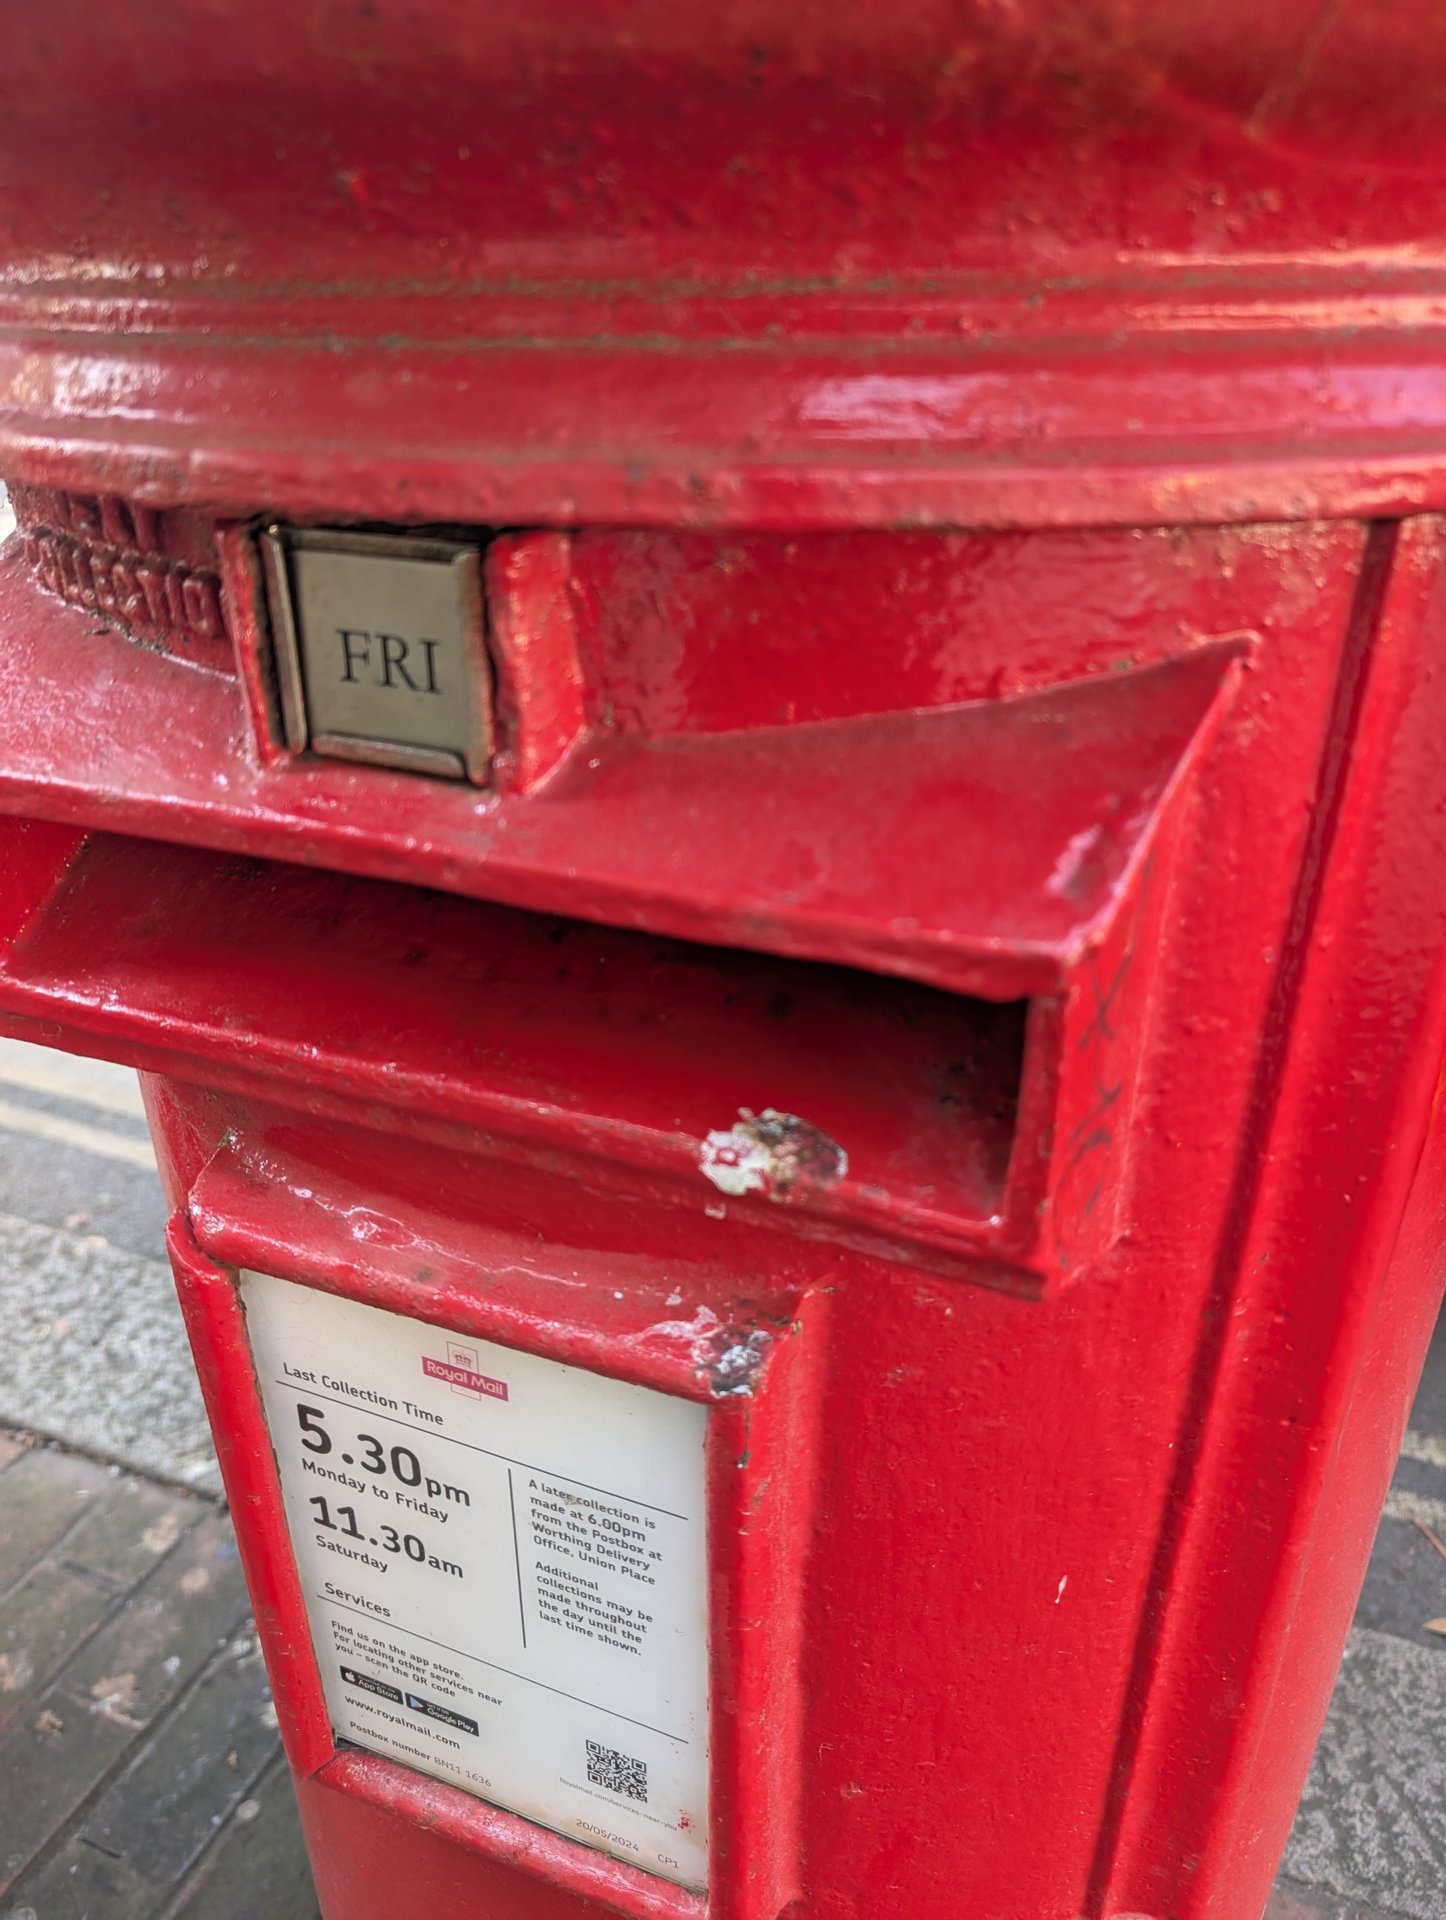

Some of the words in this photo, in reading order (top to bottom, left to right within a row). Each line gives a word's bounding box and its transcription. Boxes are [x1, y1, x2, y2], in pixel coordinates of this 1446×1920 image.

[336, 627, 443, 695] FRI
[283, 1362, 317, 1383] Last
[322, 1375, 398, 1410] Collection
[402, 1401, 443, 1425] Time
[427, 1361, 466, 1382] Royal
[471, 1376, 503, 1395] Mail
[297, 1403, 470, 1506] 5.30pm
[302, 1458, 366, 1493] Monday
[372, 1485, 388, 1499] to
[396, 1492, 448, 1523] Friday
[529, 1479, 537, 1489] A
[576, 1498, 639, 1524] collection
[645, 1517, 655, 1529] is
[309, 1496, 463, 1578] 11.30am
[530, 1497, 565, 1514] made
[570, 1511, 583, 1521] at
[588, 1514, 645, 1541] 6.00pm
[531, 1509, 561, 1526] from
[566, 1521, 587, 1535] the
[592, 1529, 643, 1554] Postbox
[648, 1551, 662, 1561] at
[316, 1535, 388, 1573] Saturday
[532, 1521, 591, 1551] Worthing
[597, 1544, 650, 1570] Delivery
[534, 1535, 573, 1557] Office,
[579, 1551, 615, 1571] Union
[621, 1566, 655, 1585] Place
[325, 1582, 390, 1617] Services
[536, 1561, 598, 1590] Additional
[537, 1576, 602, 1604] collections
[607, 1601, 633, 1616] may
[638, 1610, 653, 1622] be
[538, 1588, 571, 1605] made
[575, 1601, 647, 1633] throughout
[538, 1599, 558, 1612] the
[563, 1609, 584, 1622] day
[589, 1619, 616, 1634] until
[621, 1630, 642, 1643] the
[540, 1611, 562, 1626] last
[566, 1621, 593, 1637] time
[598, 1635, 641, 1655] shown.
[331, 1620, 353, 1635] Find
[357, 1632, 369, 1641] us
[373, 1639, 385, 1648] on
[389, 1644, 406, 1656] the
[410, 1654, 429, 1666] app
[433, 1663, 463, 1680] store.
[333, 1631, 350, 1643] For
[353, 1639, 394, 1663] locating
[398, 1659, 426, 1674] other
[430, 1672, 474, 1694] services
[478, 1692, 502, 1705] near
[335, 1643, 353, 1655] you
[365, 1656, 388, 1669] scan
[392, 1666, 408, 1678] the
[413, 1674, 427, 1685] QR
[431, 1683, 455, 1697] code
[358, 1677, 375, 1690] App
[377, 1686, 398, 1700] Store
[345, 1696, 460, 1749] www.royalmail.com
[427, 1706, 456, 1726] Google
[458, 1720, 474, 1733] Play
[350, 1721, 389, 1742] Postbox
[392, 1740, 431, 1760] number
[434, 1756, 461, 1774] BN11
[465, 1771, 491, 1787] 1636
[576, 1819, 639, 1851] 20/05/2024
[658, 1854, 679, 1869] CP1
